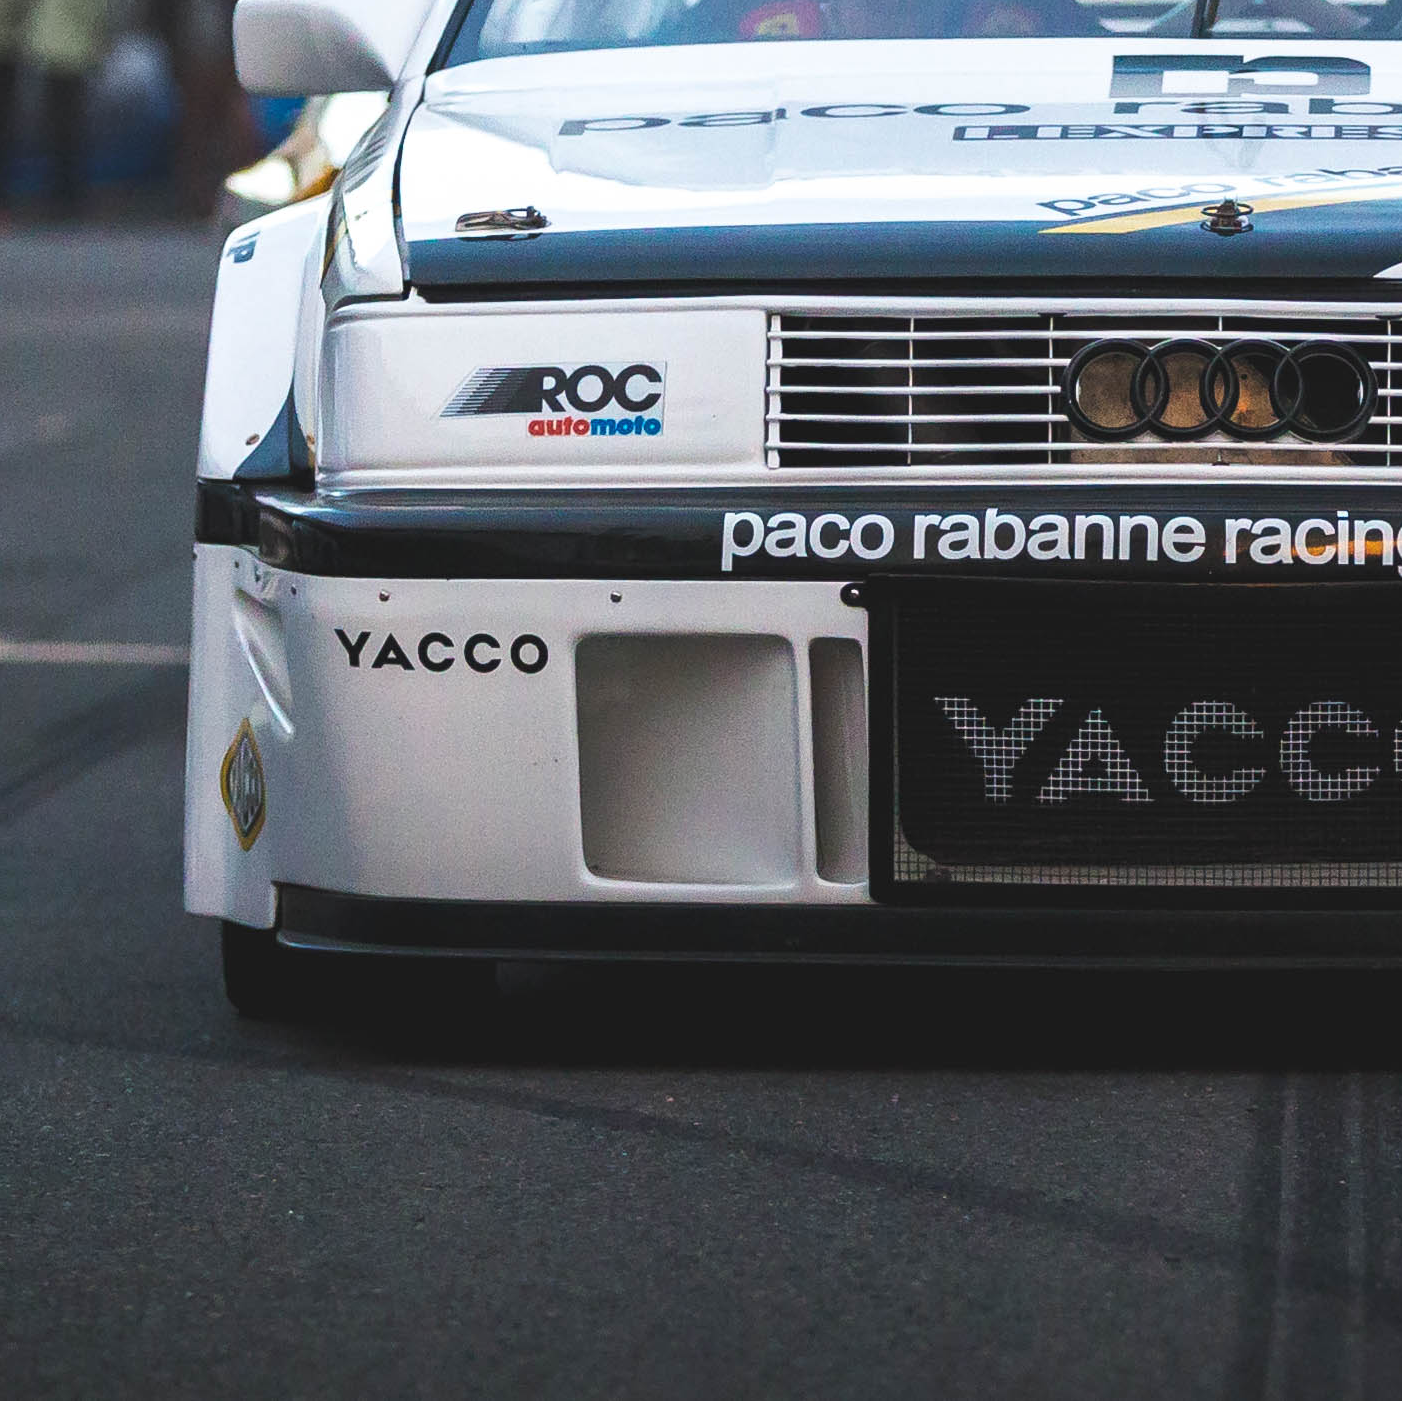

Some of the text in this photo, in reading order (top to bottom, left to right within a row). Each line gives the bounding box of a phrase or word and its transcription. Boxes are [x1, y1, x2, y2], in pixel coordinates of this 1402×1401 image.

[558, 102, 1031, 136] paco
[1036, 182, 1237, 216] paco
[507, 364, 663, 414] ROC
[527, 415, 662, 437] automoto
[720, 510, 896, 572] paco
[912, 506, 1207, 564] rabanne
[334, 628, 549, 674] YACCO
